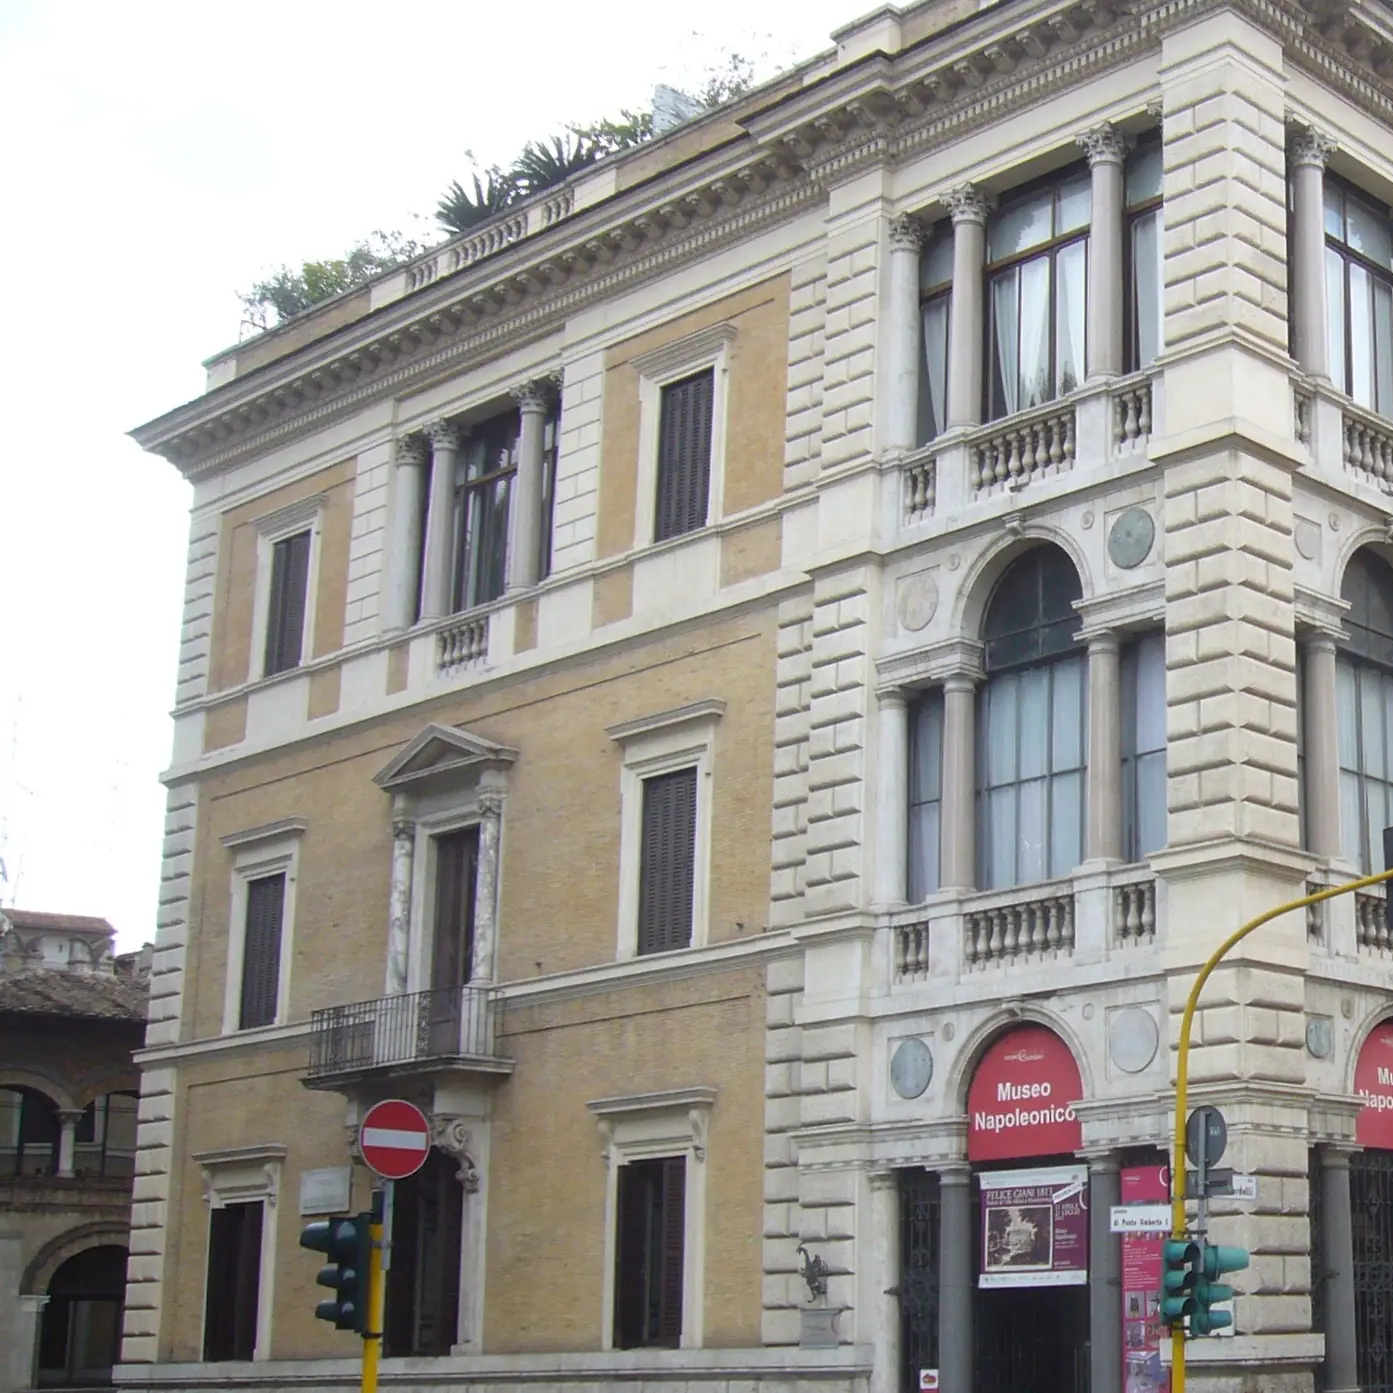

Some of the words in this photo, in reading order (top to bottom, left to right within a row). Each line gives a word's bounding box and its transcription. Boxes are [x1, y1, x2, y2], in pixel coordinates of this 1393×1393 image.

[997, 1082, 1051, 1102] Museo
[975, 1104, 1076, 1133] Napoleonico
[986, 1190, 1013, 1200] FELICE
[1013, 1188, 1035, 1199] GIANI
